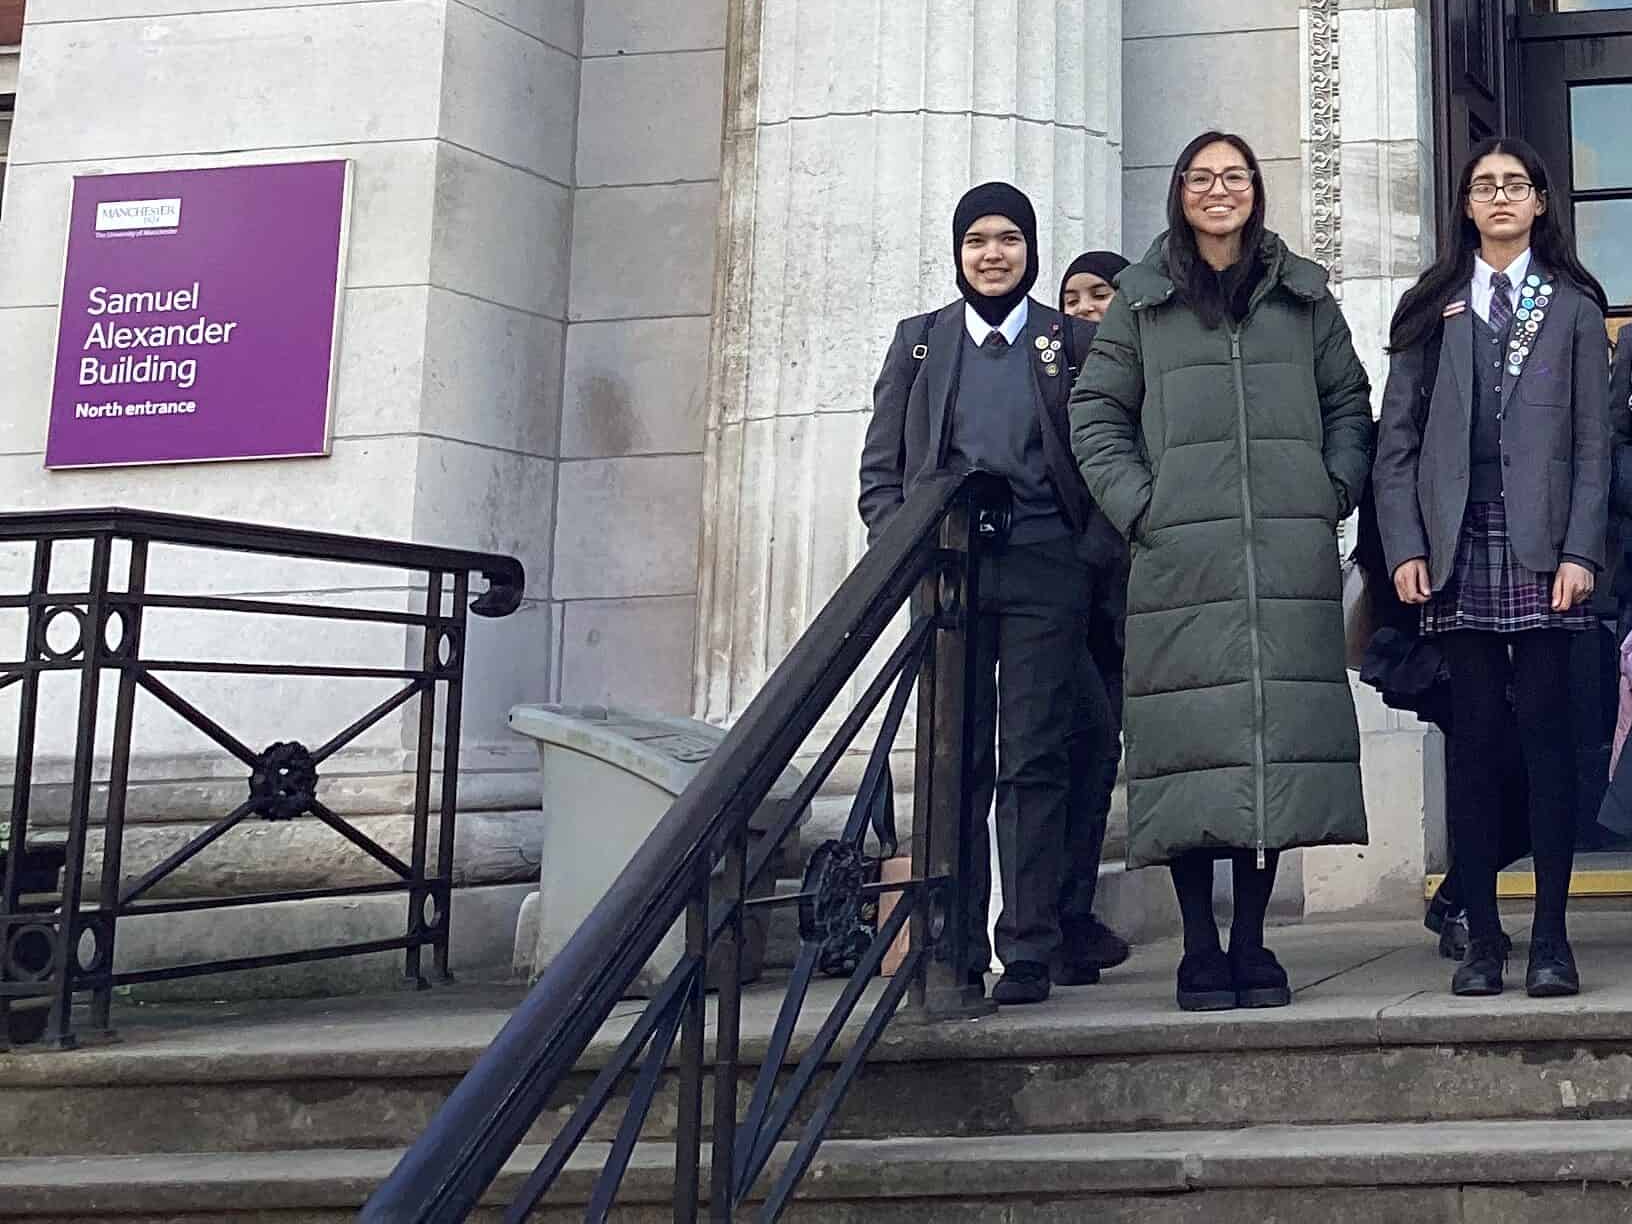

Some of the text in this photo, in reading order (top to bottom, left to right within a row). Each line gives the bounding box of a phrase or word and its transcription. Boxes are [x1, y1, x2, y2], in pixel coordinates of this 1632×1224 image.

[86, 281, 200, 316] Samuel
[83, 316, 238, 350] Alexander
[78, 354, 197, 388] Building
[75, 398, 196, 419] North entrance
